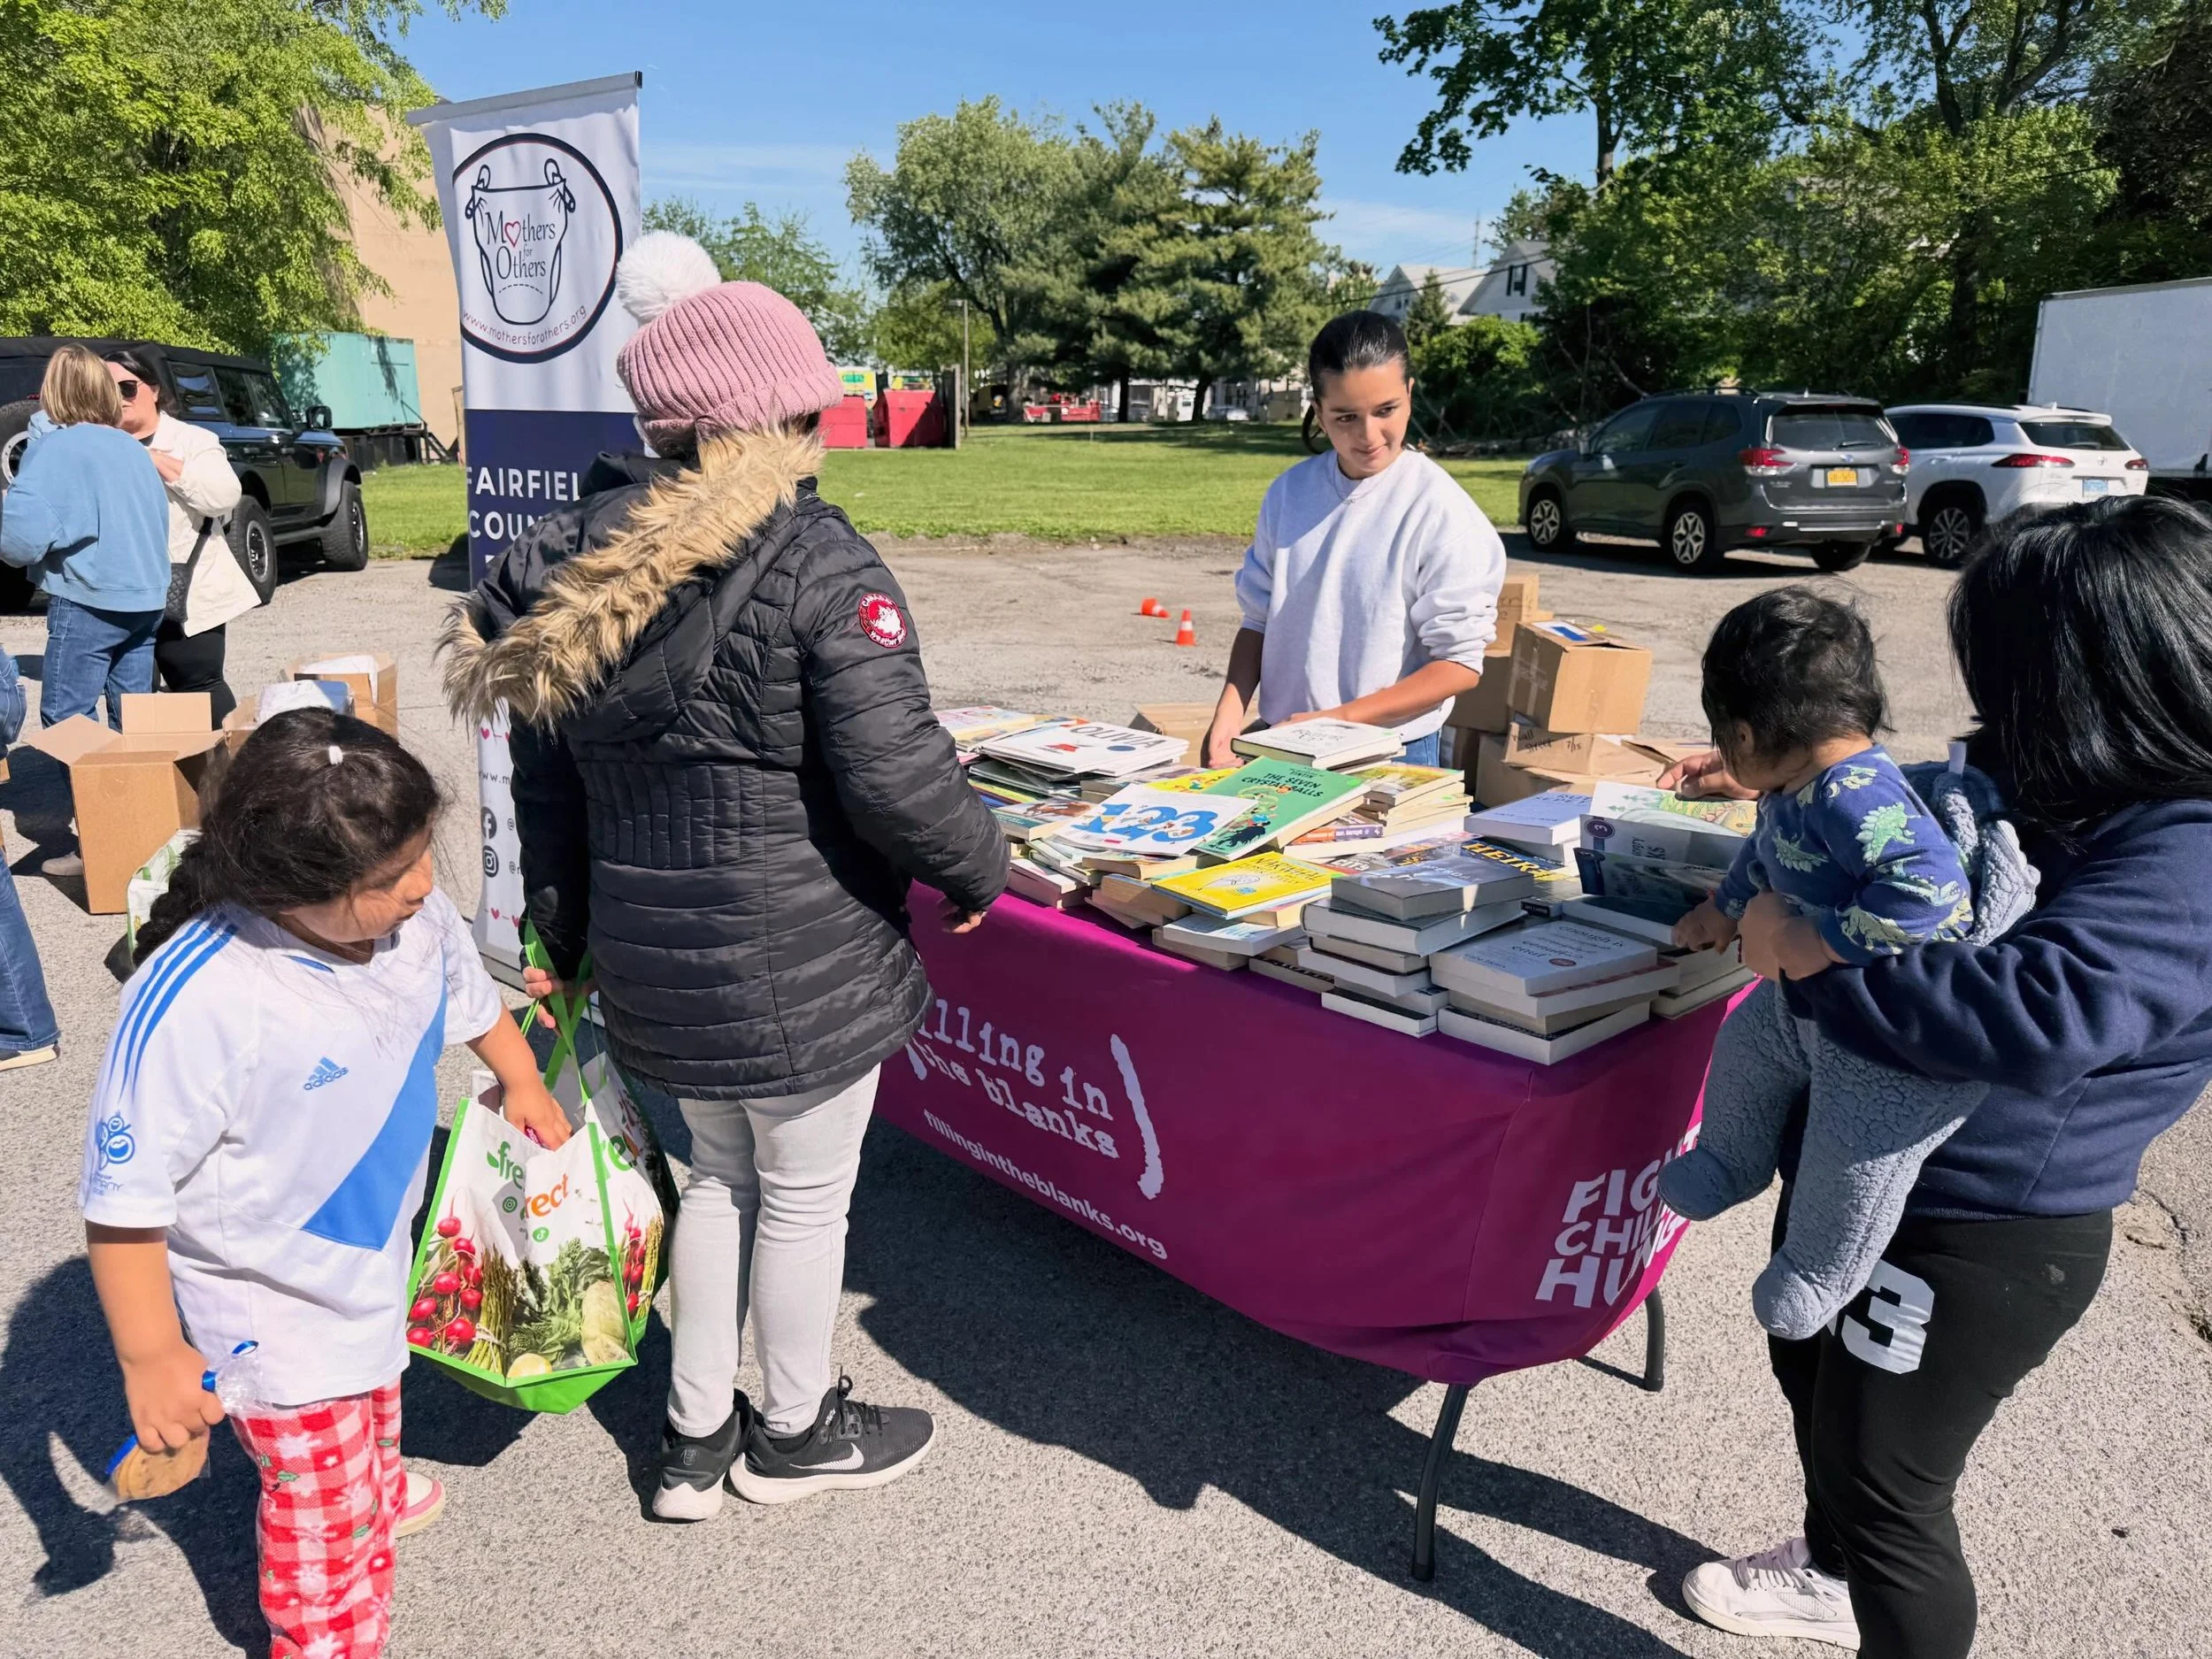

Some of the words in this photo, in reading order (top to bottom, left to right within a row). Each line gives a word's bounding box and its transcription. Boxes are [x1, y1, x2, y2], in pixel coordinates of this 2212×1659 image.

[496, 245, 547, 280] Others
[463, 304, 588, 346] www.mothersforothers.org
[1263, 772, 1286, 781] THE
[1285, 776, 1322, 789] SEVEN
[1071, 803, 1218, 842] 123
[303, 1065, 349, 1091] adidas
[918, 999, 1045, 1087] lling
[1060, 1065, 1114, 1121] in
[975, 1067, 1120, 1159] blanks
[923, 1108, 1168, 1260] fillingintheblanks.org
